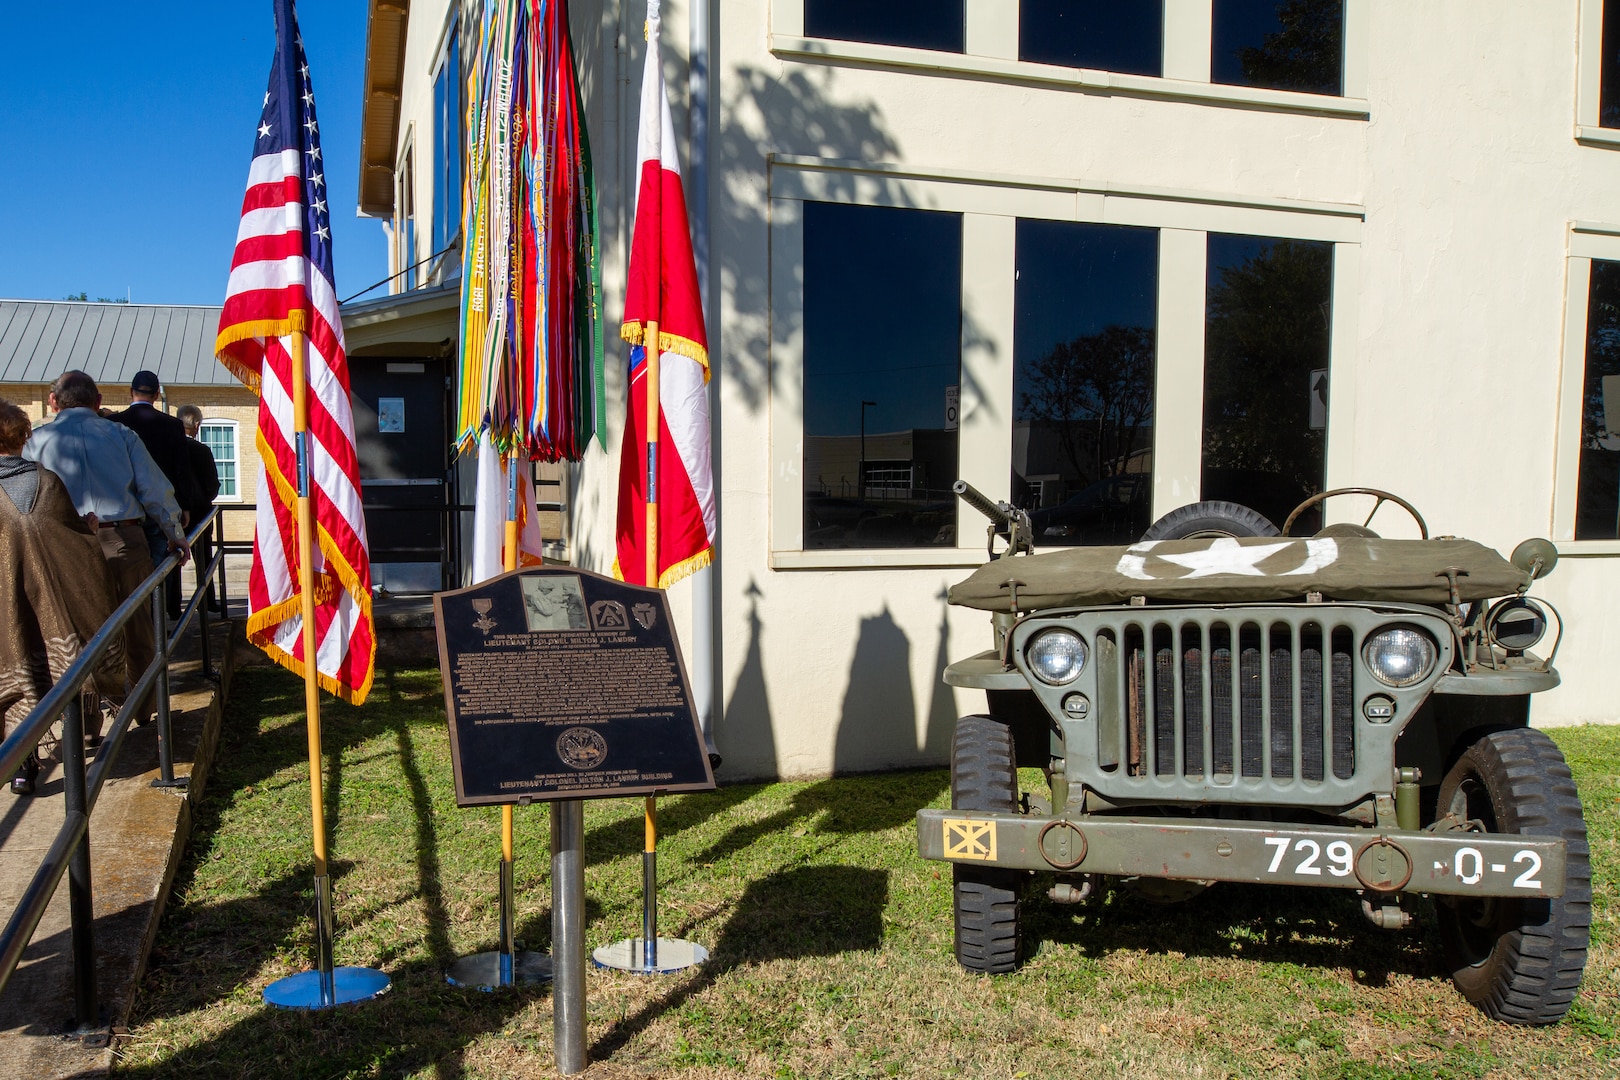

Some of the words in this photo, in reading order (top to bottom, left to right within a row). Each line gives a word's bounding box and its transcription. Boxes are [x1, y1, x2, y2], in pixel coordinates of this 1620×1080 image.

[484, 639, 531, 647] LIEUTENANT
[533, 637, 569, 646] COLONEL
[570, 637, 598, 645] MILTON
[607, 635, 637, 643] LANDRY
[500, 779, 543, 789] LIEUTENANT
[545, 778, 577, 787] COLONEL
[579, 776, 604, 784] MILTON
[641, 772, 673, 780] BUILDING
[1265, 837, 1354, 877] 729
